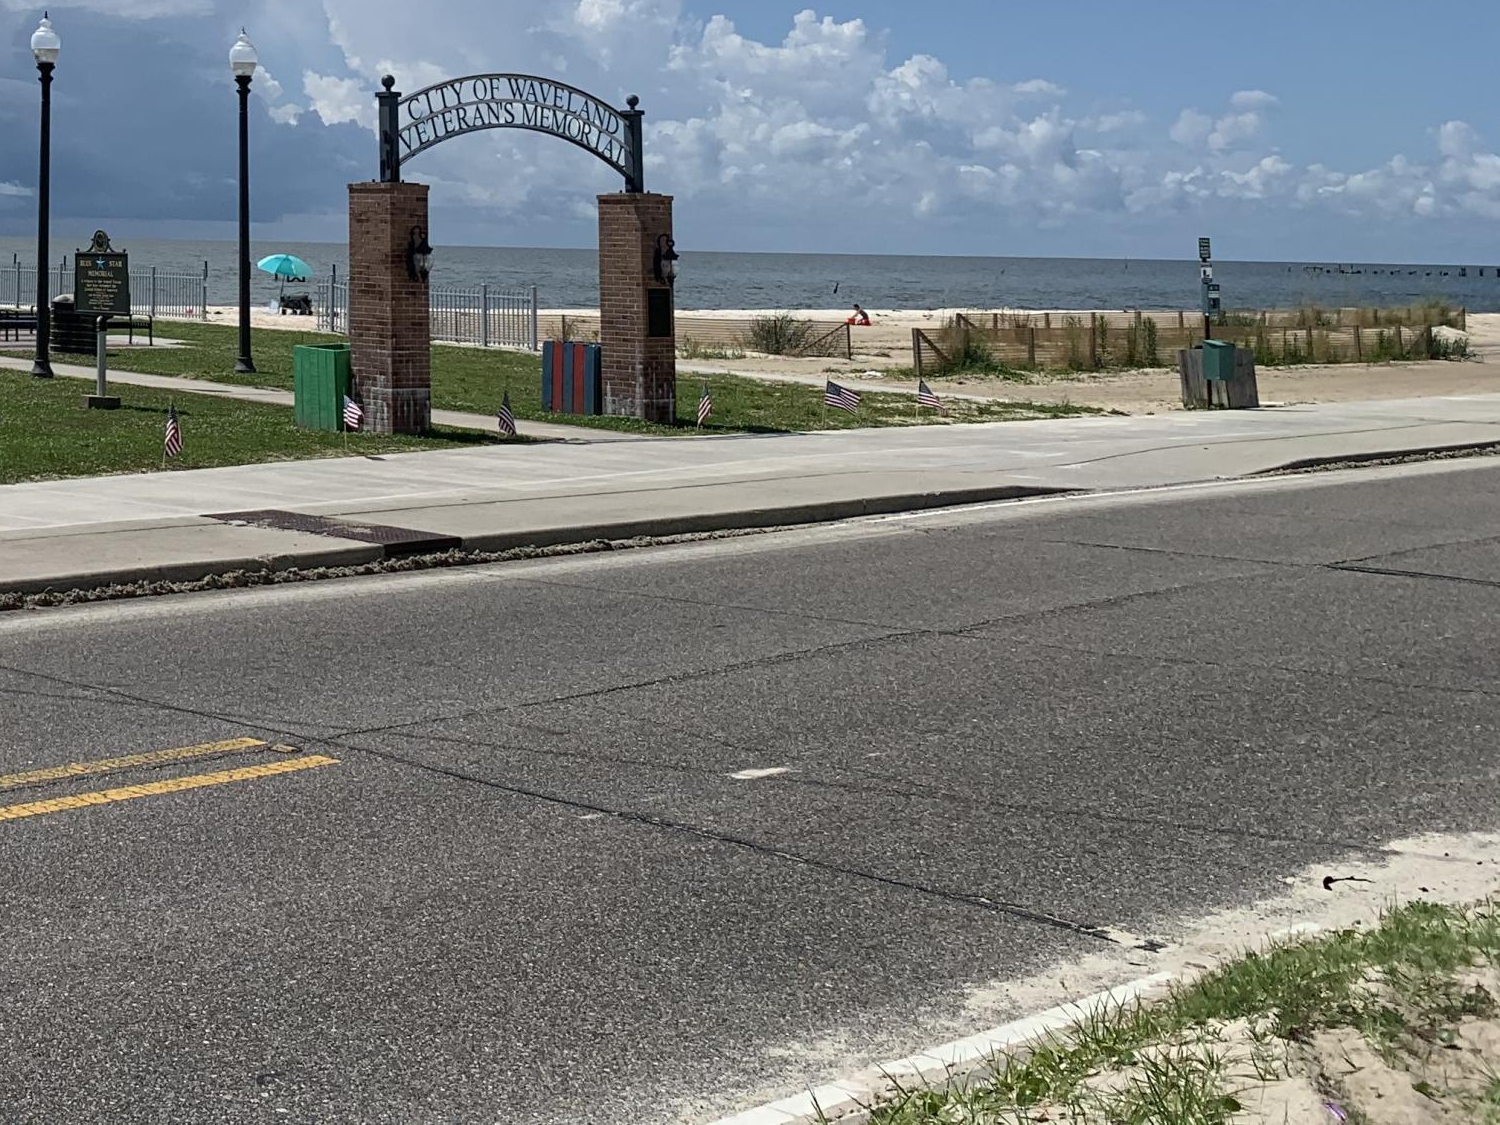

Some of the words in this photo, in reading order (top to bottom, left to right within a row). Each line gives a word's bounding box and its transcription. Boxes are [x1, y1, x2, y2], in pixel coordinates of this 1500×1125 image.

[400, 102, 515, 152] VETERAN'S
[522, 105, 627, 167] MEMORIAL
[408, 82, 464, 121] CITY
[473, 78, 500, 101] OF
[508, 78, 619, 135] WAVELAND
